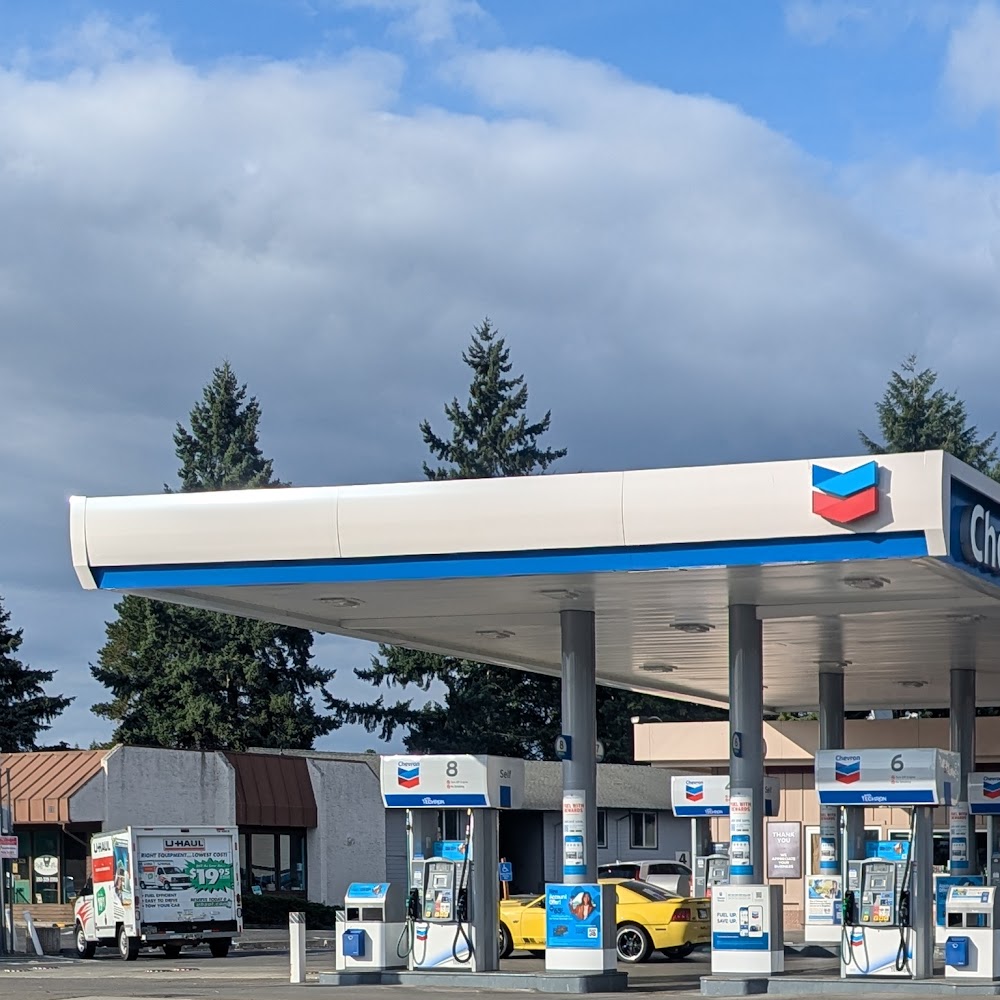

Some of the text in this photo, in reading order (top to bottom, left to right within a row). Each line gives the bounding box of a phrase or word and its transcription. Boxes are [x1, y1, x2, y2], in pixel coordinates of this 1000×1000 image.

[446, 761, 458, 777] 8
[891, 754, 904, 771] 6
[680, 853, 687, 864] 4
